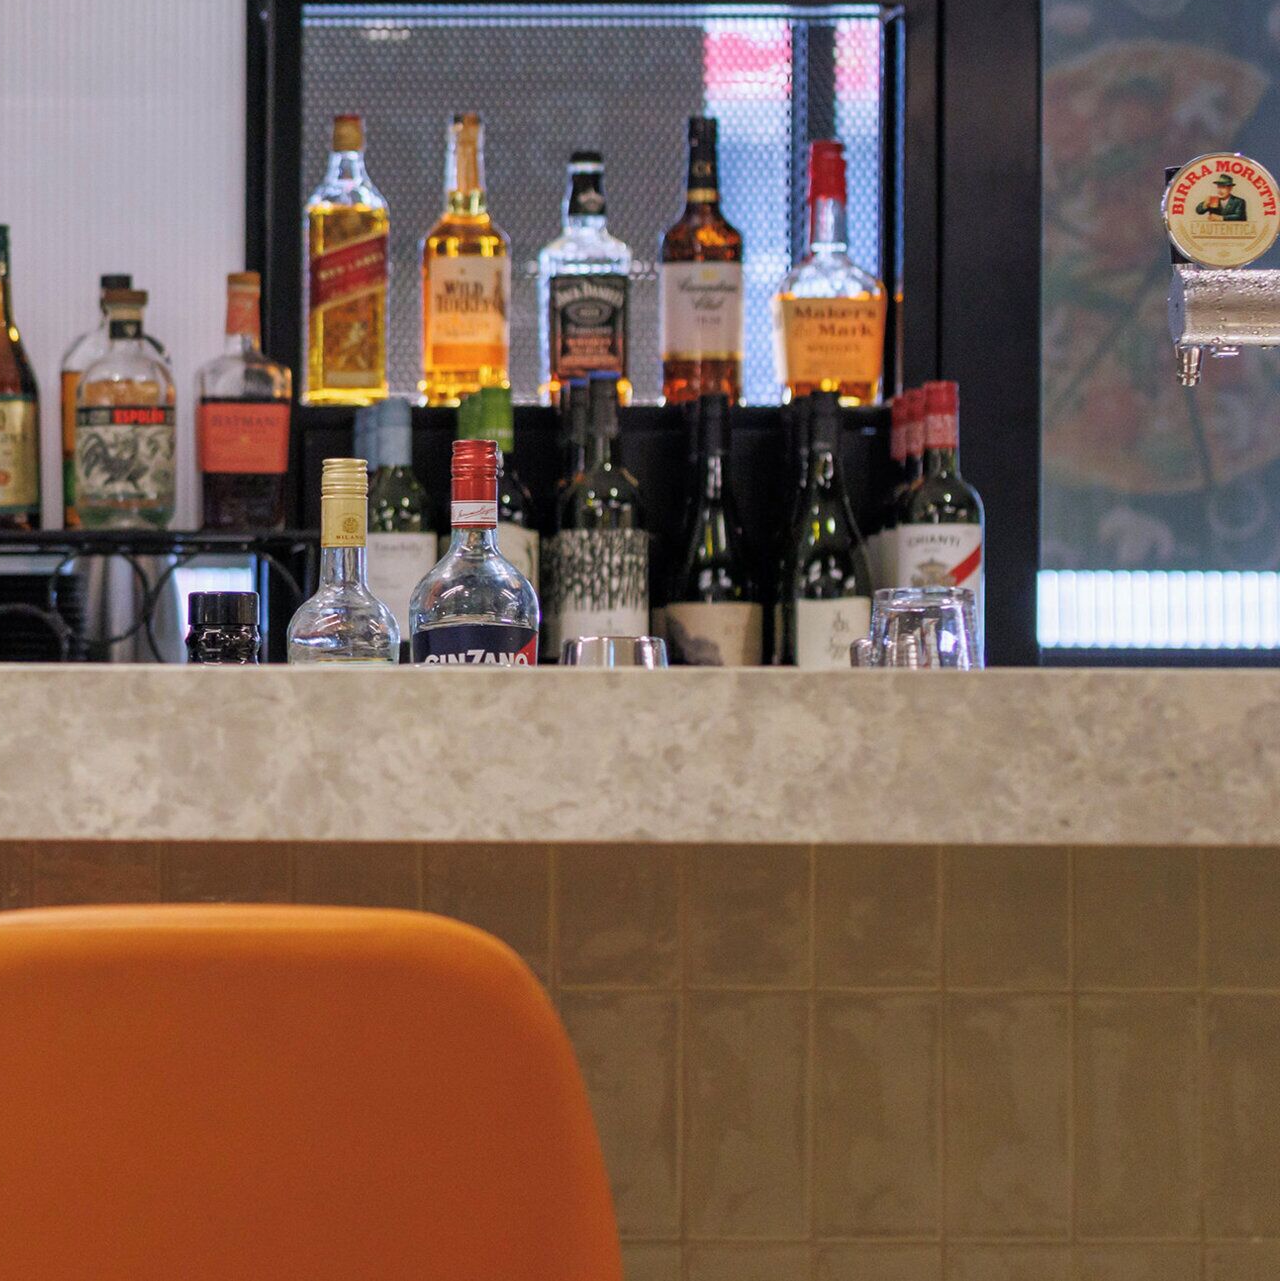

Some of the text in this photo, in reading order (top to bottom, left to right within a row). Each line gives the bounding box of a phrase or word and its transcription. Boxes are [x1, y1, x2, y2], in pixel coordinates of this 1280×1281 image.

[1172, 160, 1277, 216] BIRRA MORETTI
[444, 281, 484, 296] WILD
[795, 306, 876, 319] Maker's
[819, 323, 873, 336] Mark
